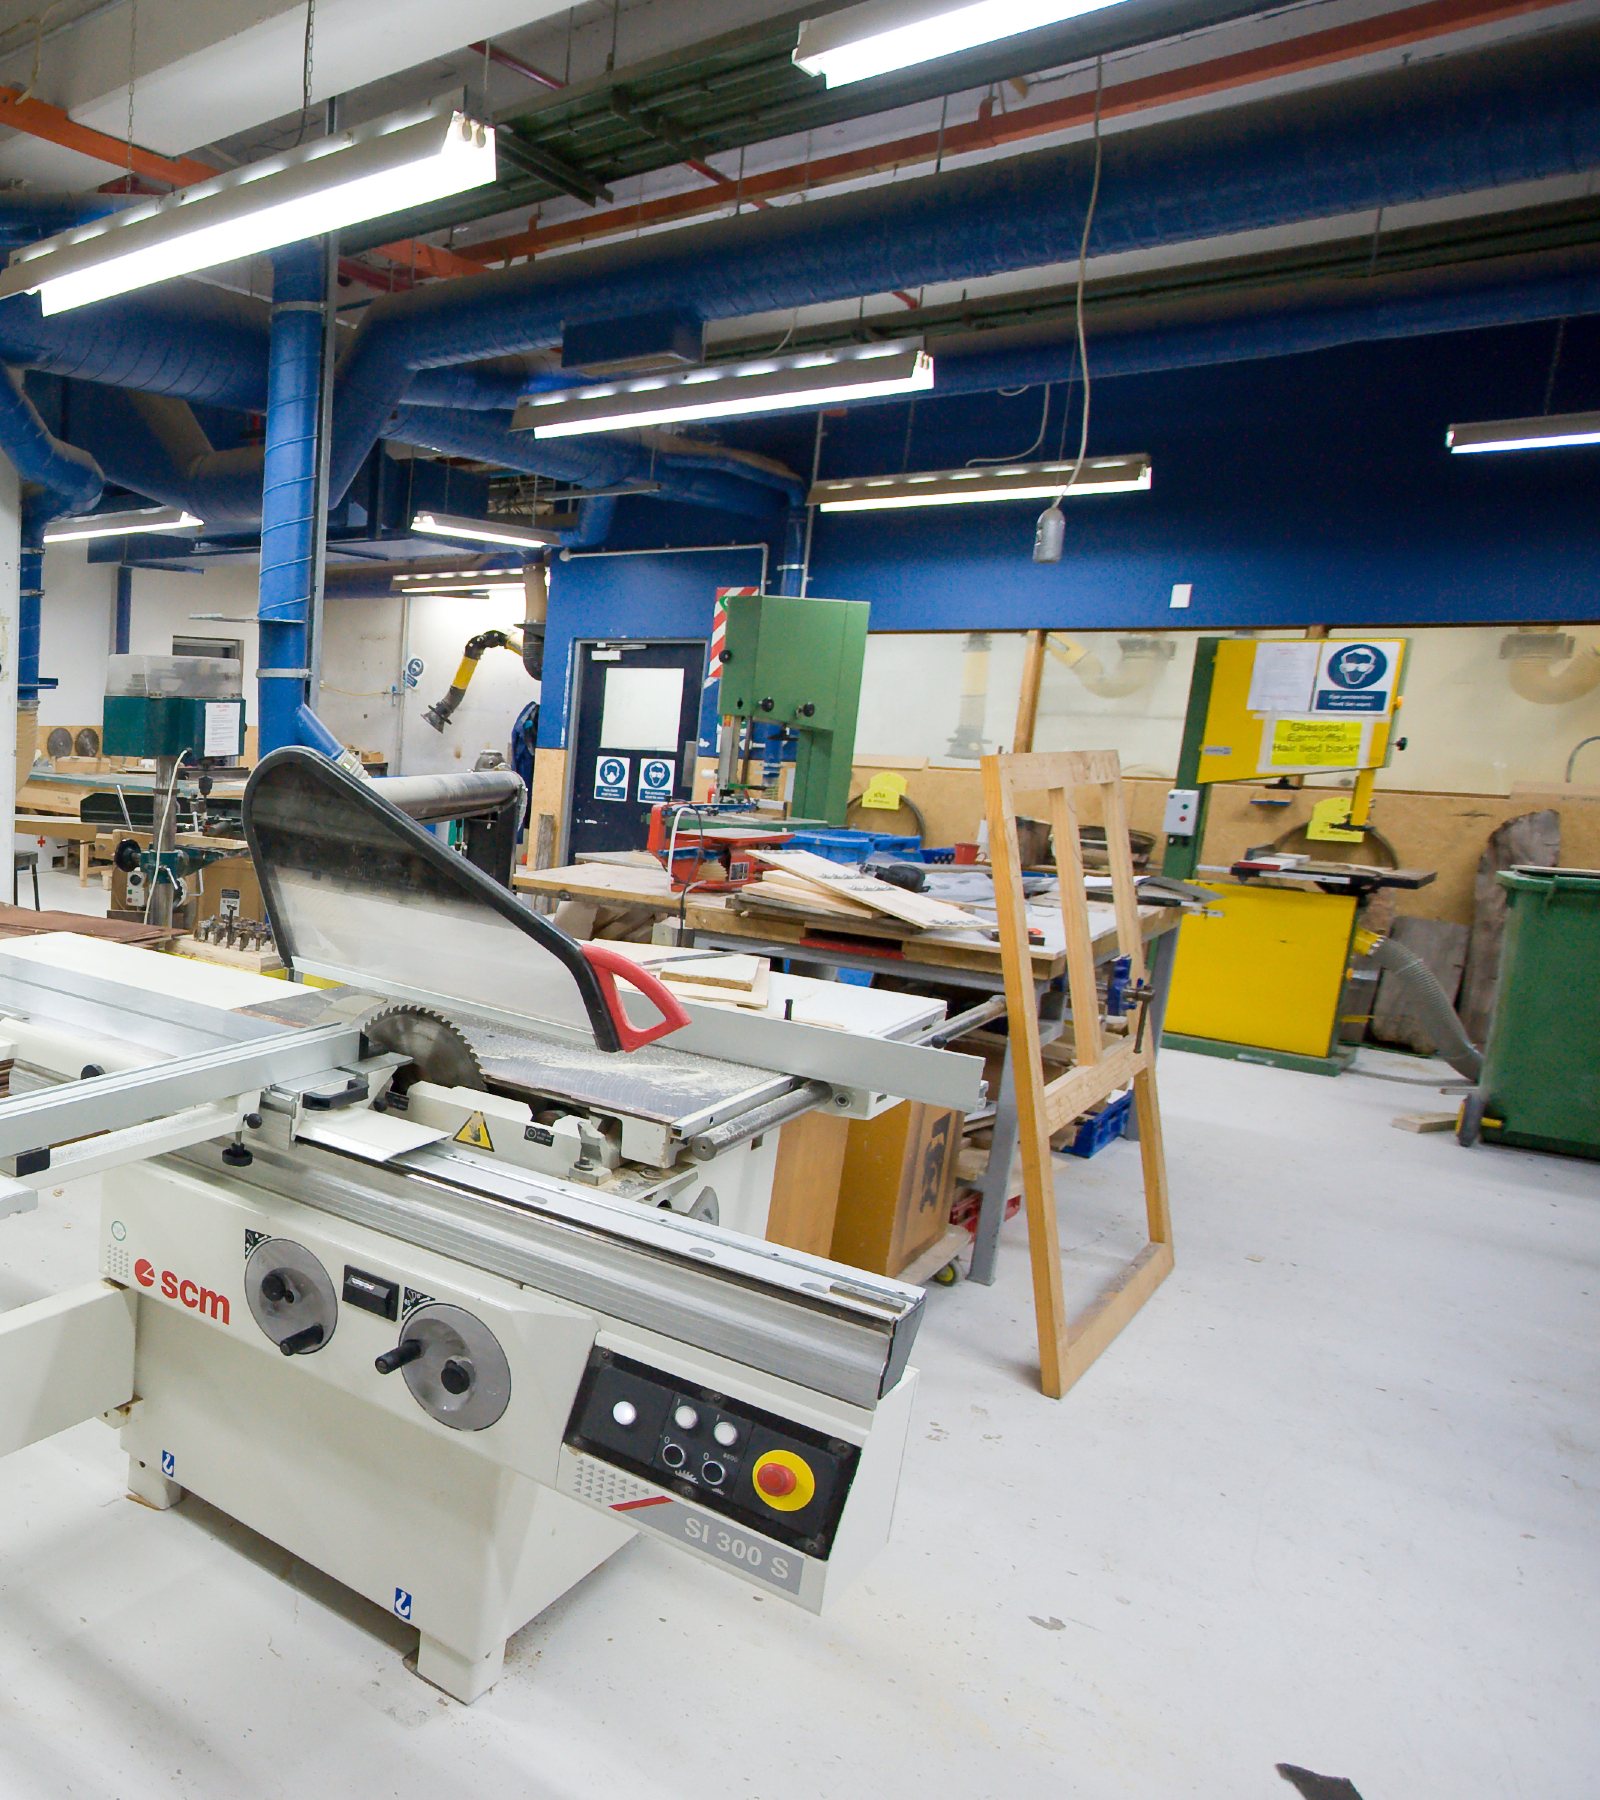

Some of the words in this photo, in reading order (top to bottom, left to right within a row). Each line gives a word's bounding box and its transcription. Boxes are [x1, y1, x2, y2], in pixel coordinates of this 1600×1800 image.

[1291, 722, 1345, 731] Glasses!
[1286, 732, 1346, 742] Earmuffs!
[1273, 744, 1295, 752] Hair
[1299, 744, 1322, 752] tied
[161, 1270, 229, 1325] scm
[684, 1518, 709, 1544] SI
[716, 1531, 762, 1566] 300
[770, 1557, 789, 1579] S
